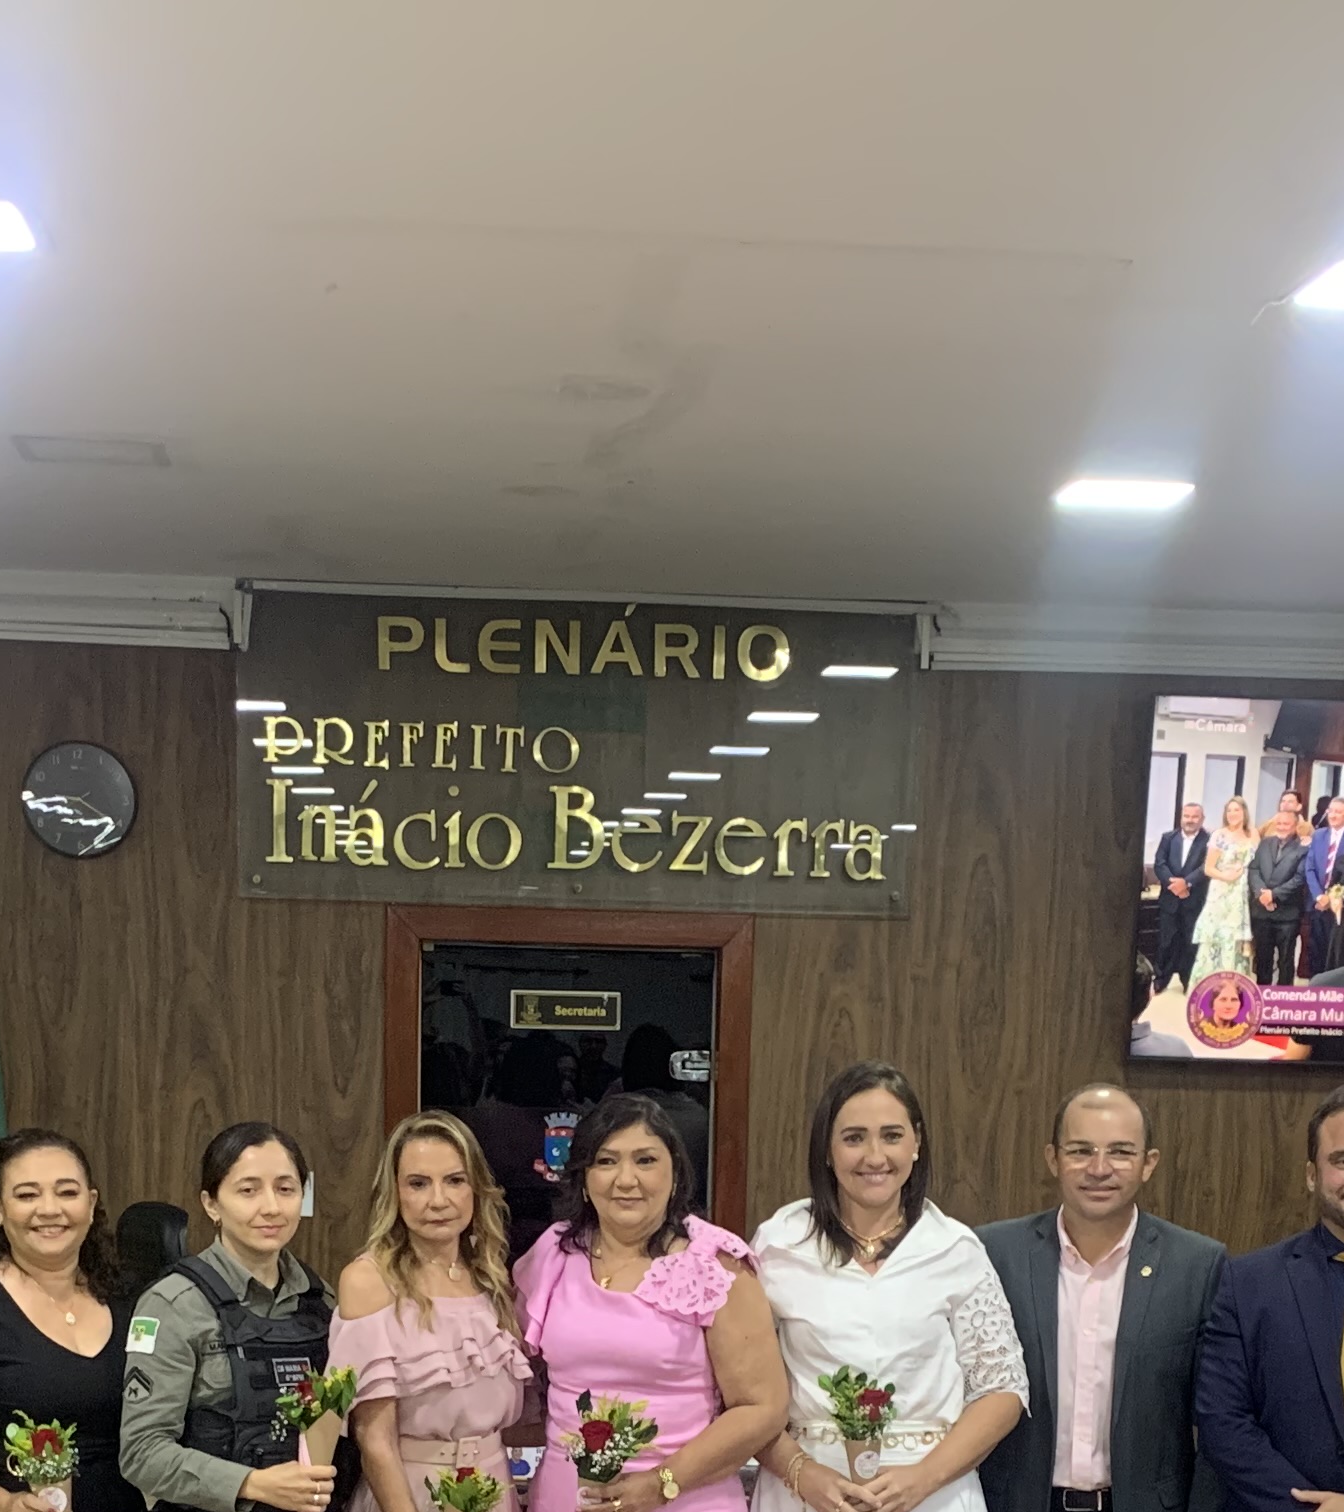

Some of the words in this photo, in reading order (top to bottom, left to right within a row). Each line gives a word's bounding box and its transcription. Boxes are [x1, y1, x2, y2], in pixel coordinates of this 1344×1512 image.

[377, 602, 790, 682] PLENÁRIO
[1196, 718, 1247, 733] Câmara
[262, 716, 580, 773] PREFEITO
[73, 749, 83, 759] 12
[265, 779, 522, 870] Inácio
[546, 785, 887, 881] Bezerra
[1262, 988, 1317, 1001] Comenda
[1319, 990, 1344, 1002] Mãe
[554, 1005, 607, 1017] Secretaria
[1262, 1005, 1317, 1021] Câmara
[1259, 1025, 1291, 1035] Plenário
[1291, 1026, 1320, 1035] Prefeito
[1320, 1028, 1343, 1036] Inácio
